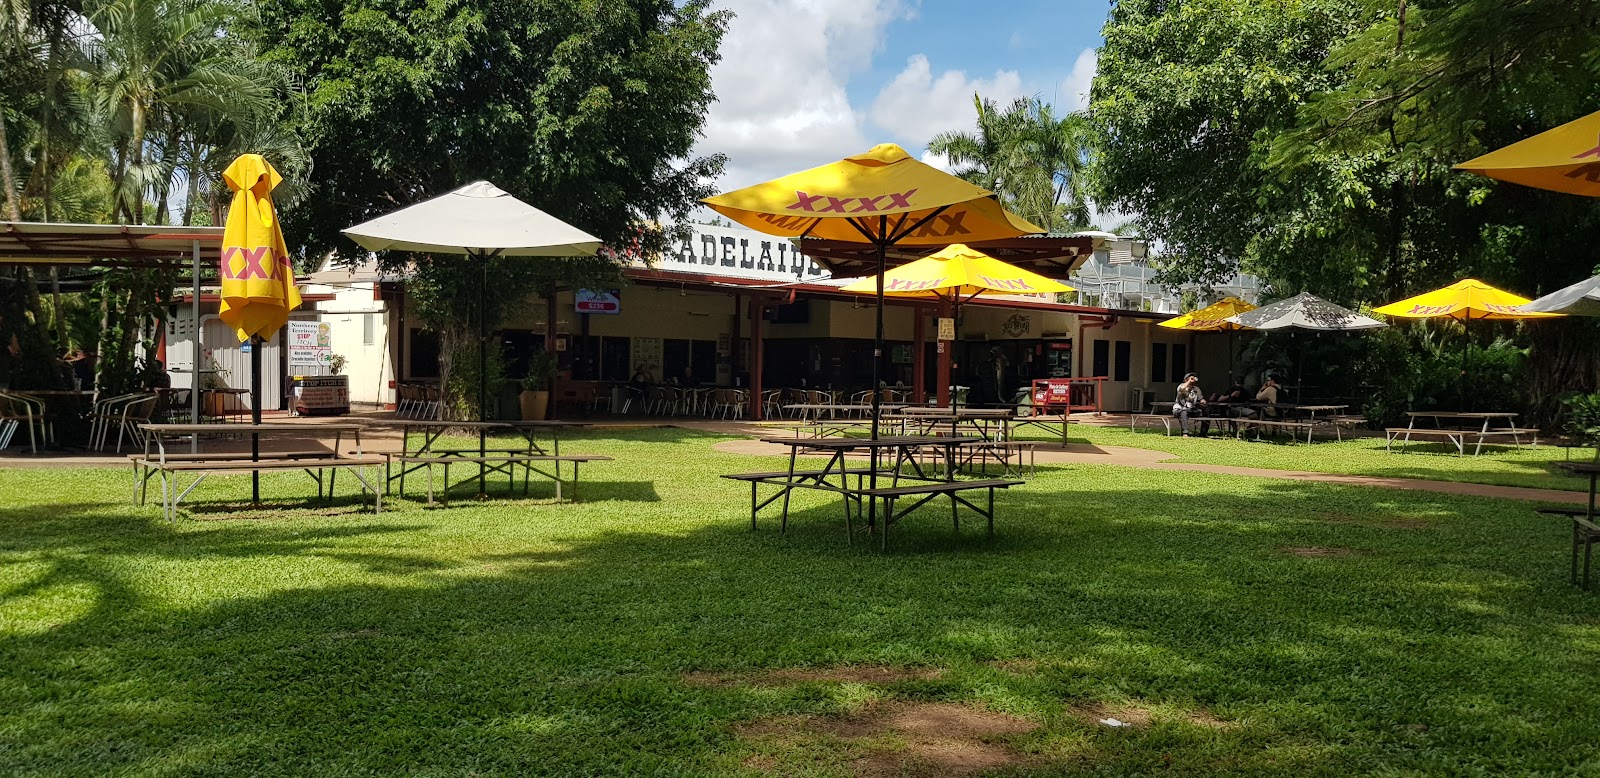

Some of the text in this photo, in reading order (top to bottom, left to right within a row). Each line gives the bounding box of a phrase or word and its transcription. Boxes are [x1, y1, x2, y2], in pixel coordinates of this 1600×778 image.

[786, 188, 918, 213] XXXX
[884, 277, 948, 290] XXXX
[977, 274, 1036, 290] XXXX
[1407, 302, 1459, 314] XXXX
